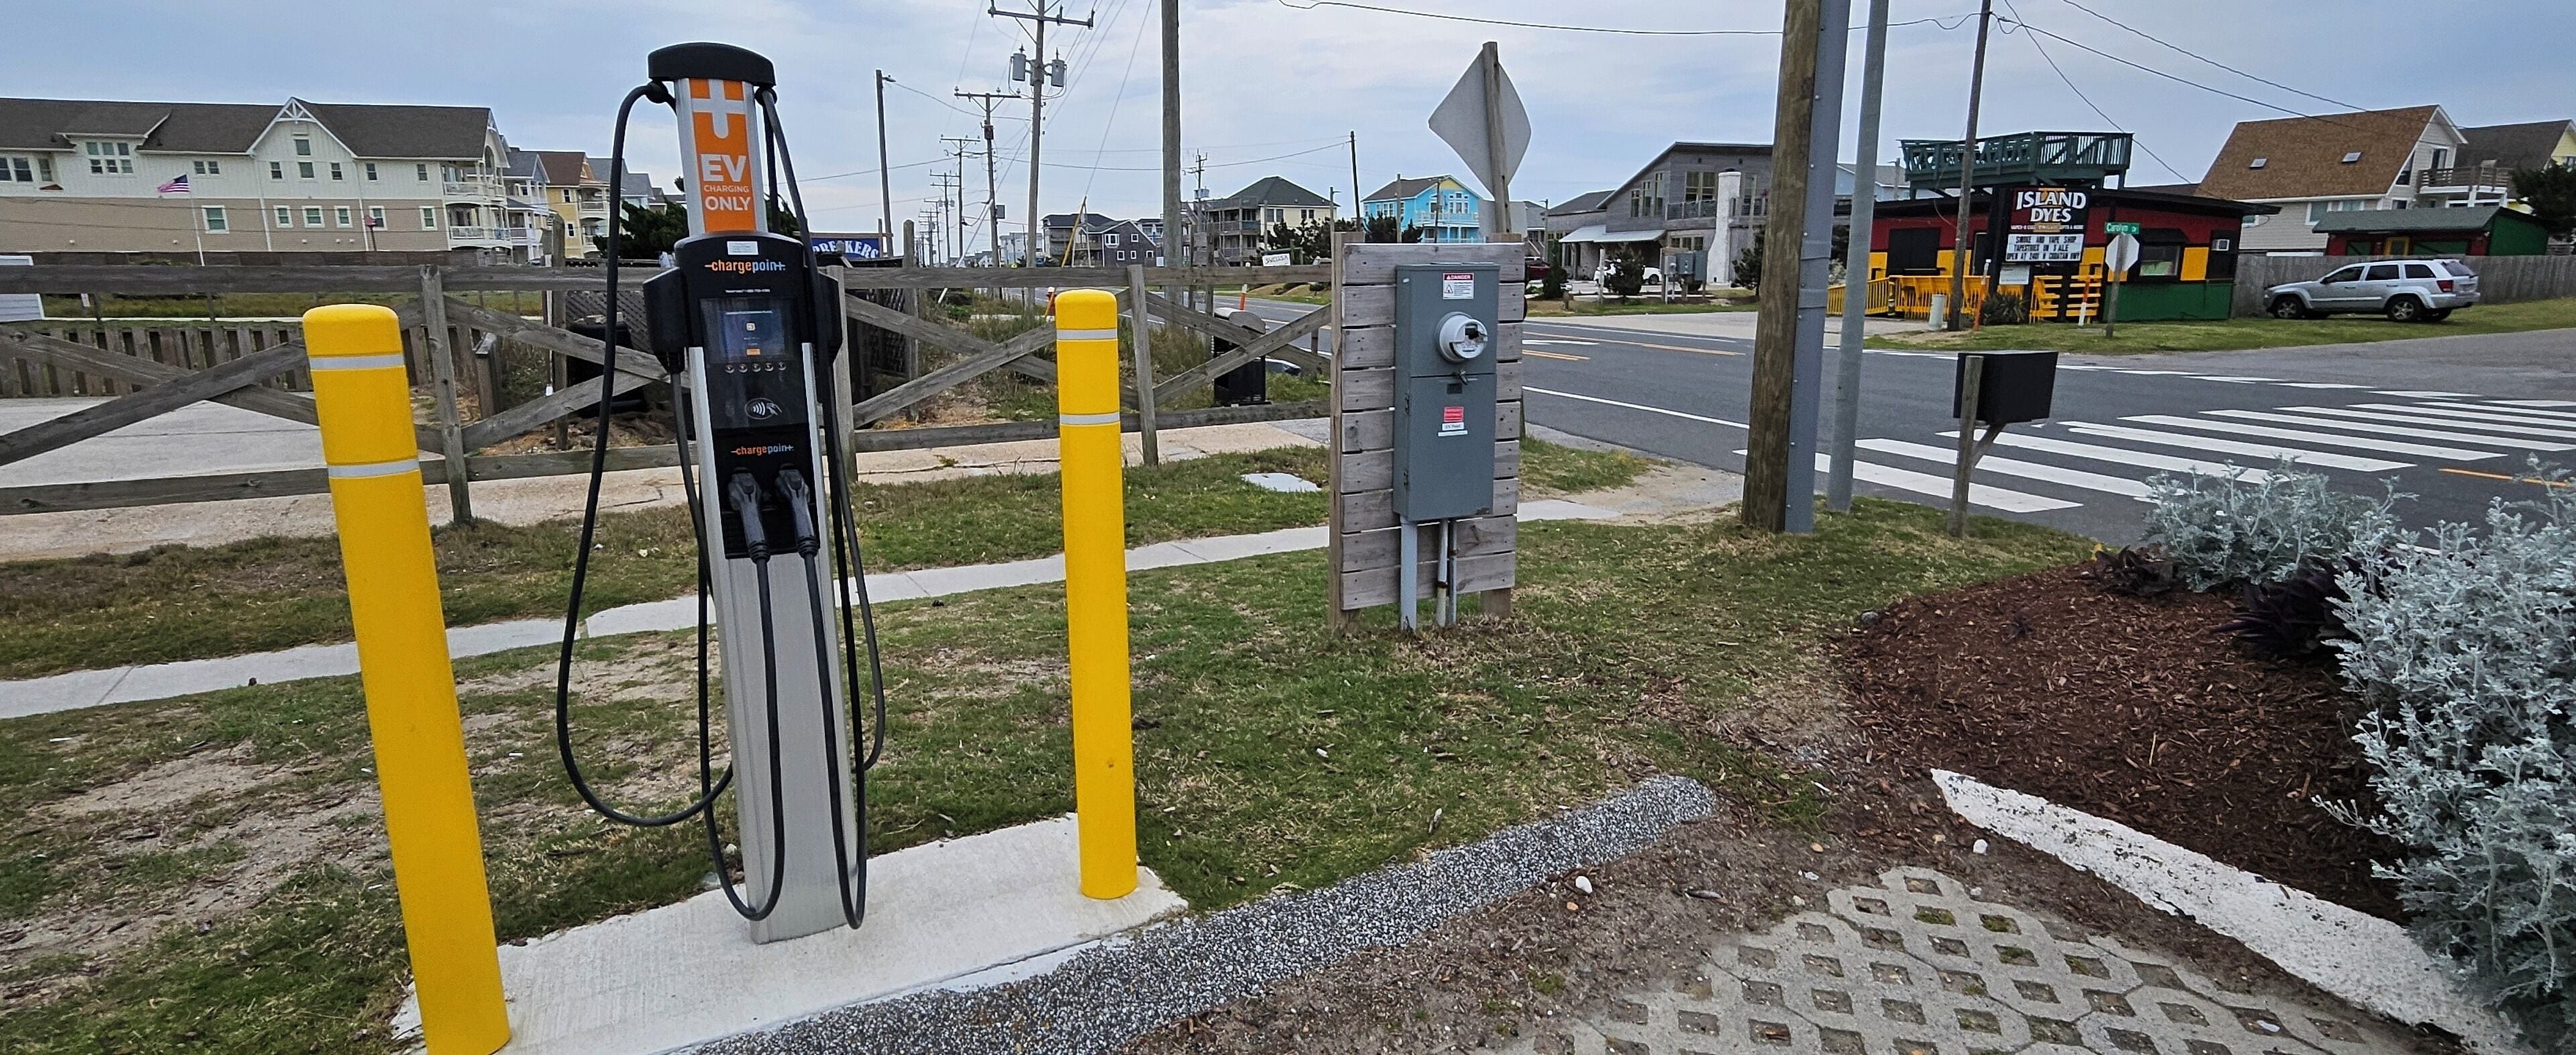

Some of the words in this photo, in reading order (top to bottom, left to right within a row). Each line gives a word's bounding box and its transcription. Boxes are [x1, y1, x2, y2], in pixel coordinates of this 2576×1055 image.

[700, 154, 747, 183] EV
[704, 185, 749, 193] CHARGING
[705, 196, 751, 211] ONLY
[2016, 191, 2086, 210] ISLAND
[2030, 208, 2072, 222] DYES
